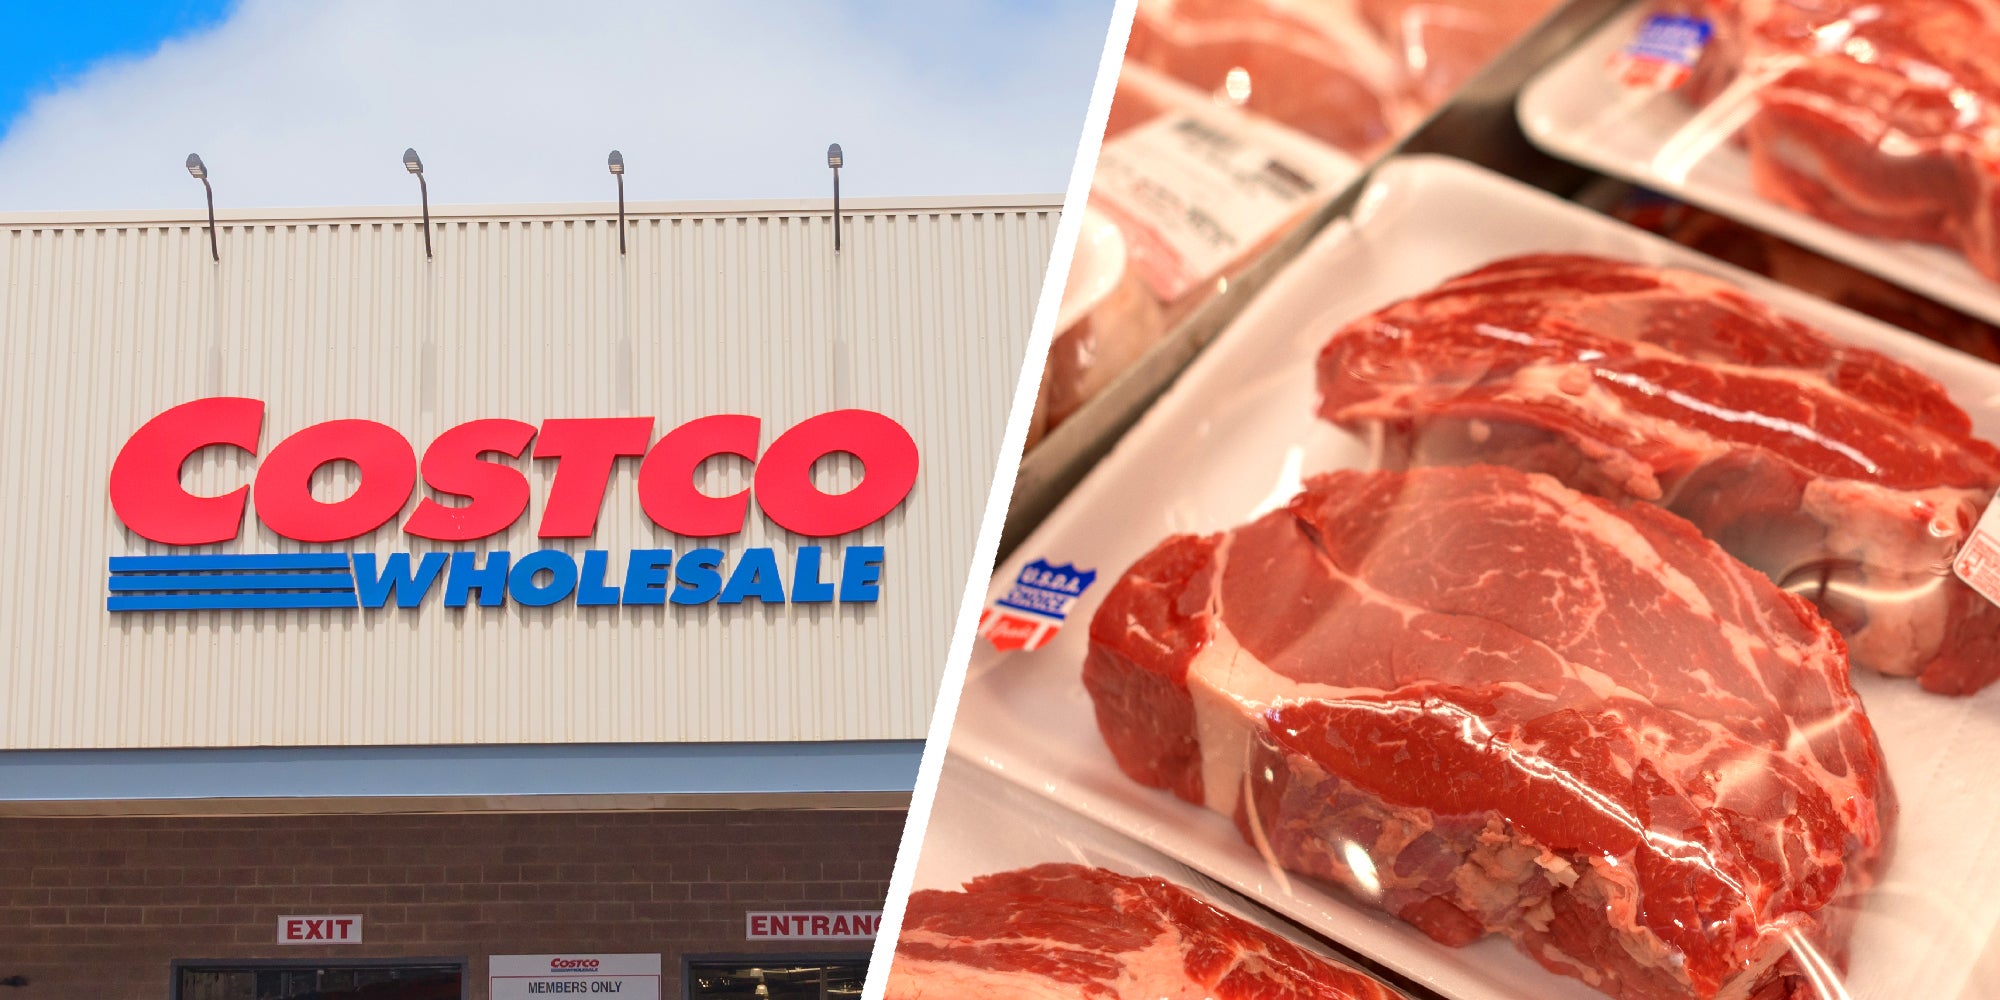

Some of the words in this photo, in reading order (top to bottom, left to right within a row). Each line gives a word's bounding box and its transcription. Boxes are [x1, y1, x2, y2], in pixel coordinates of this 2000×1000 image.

[110, 397, 919, 543] COSTCO
[353, 546, 884, 608] WHOLESALE
[287, 919, 353, 939] EXIT
[551, 958, 599, 968] COSTCO
[528, 982, 587, 993] MEMBERS
[591, 981, 622, 993] ONLY
